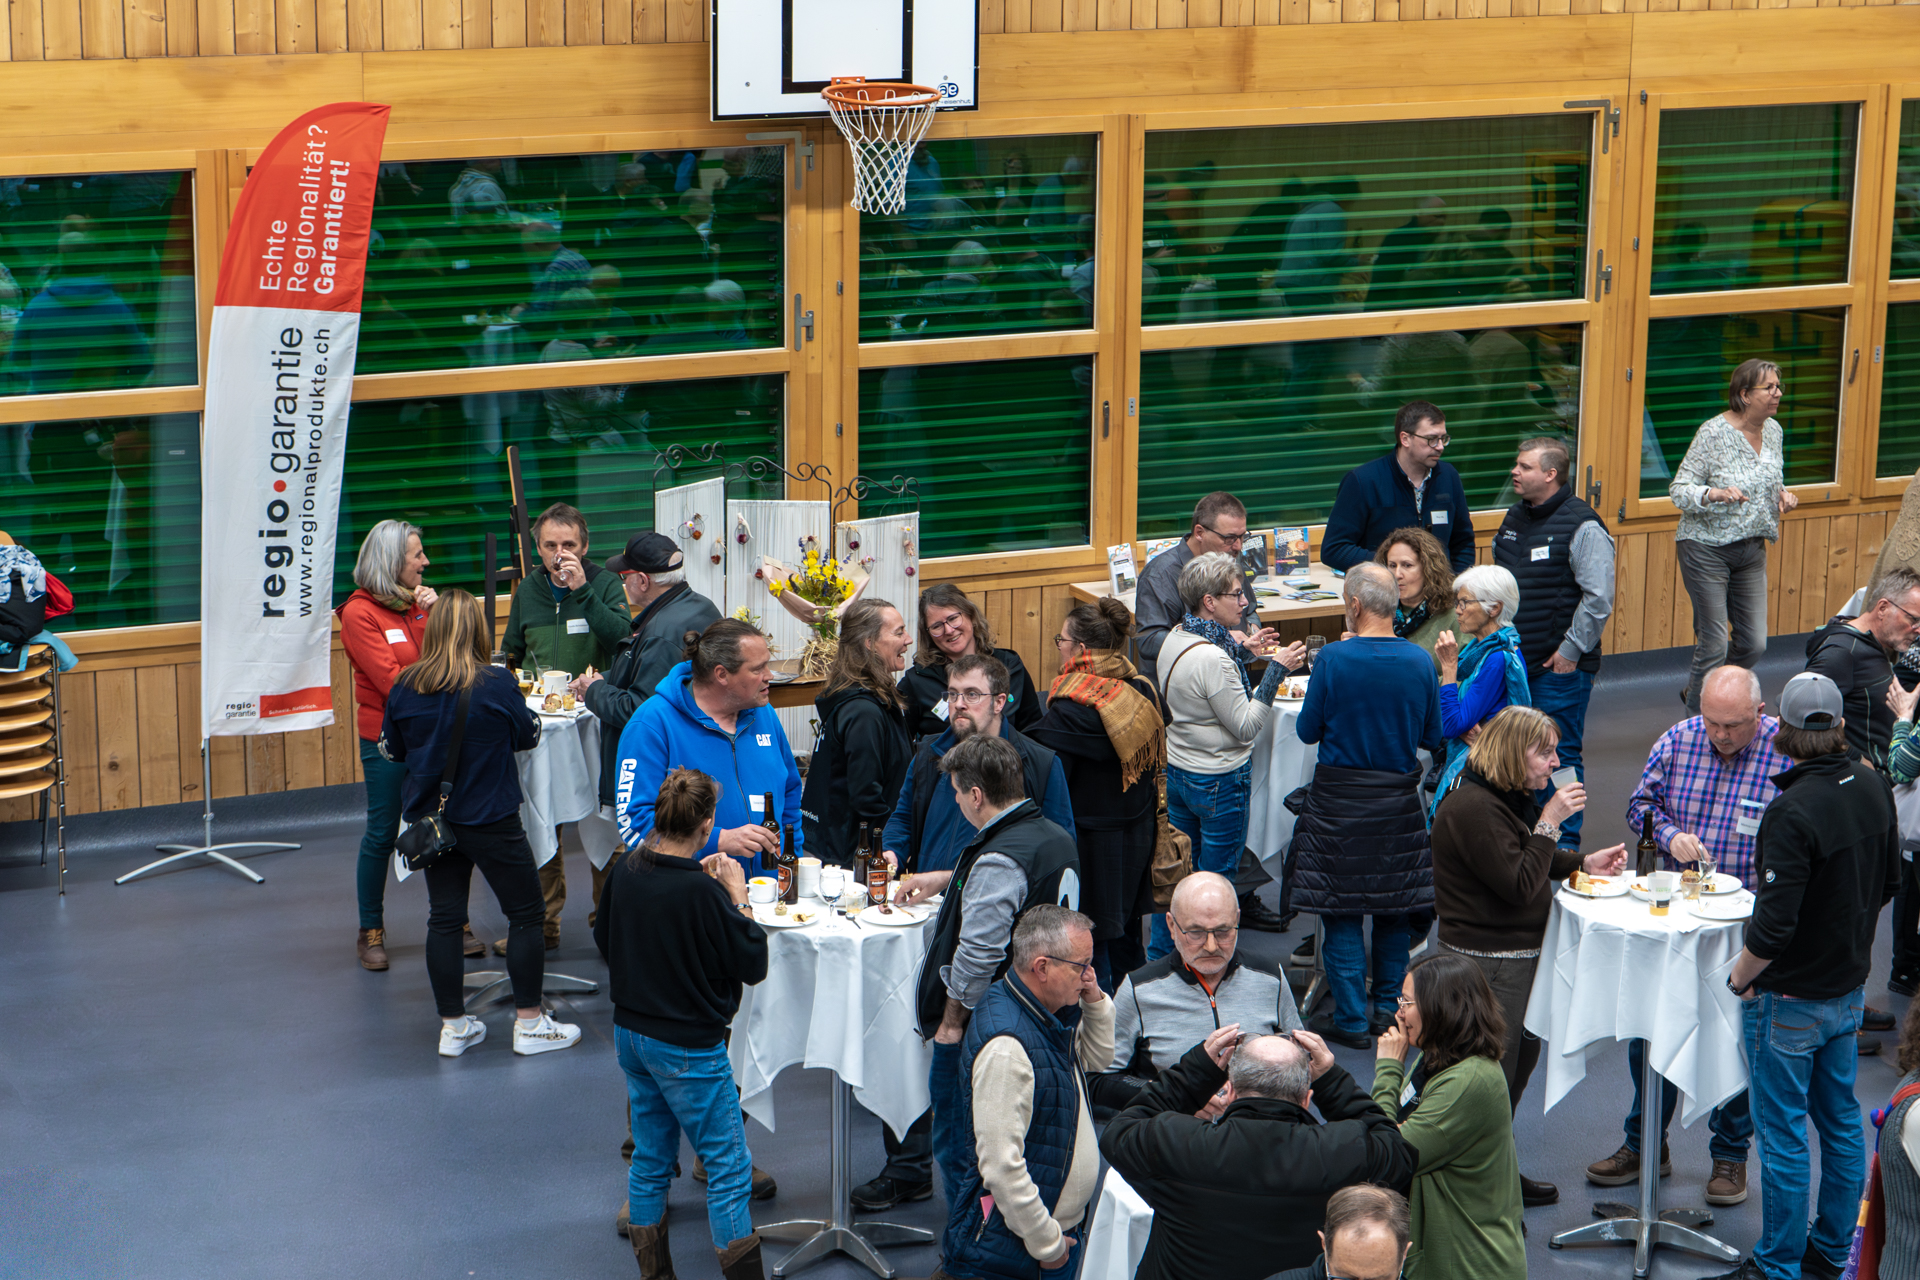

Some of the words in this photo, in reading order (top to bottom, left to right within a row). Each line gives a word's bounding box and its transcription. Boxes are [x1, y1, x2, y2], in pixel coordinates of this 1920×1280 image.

[260, 219, 288, 291] Echte
[313, 159, 351, 295] Garantiert!
[270, 327, 303, 474] garantie
[299, 328, 330, 618] www.regionalprodukte.ch
[226, 702, 252, 711] regio
[226, 711, 256, 719] garantie
[755, 733, 772, 747] CAT
